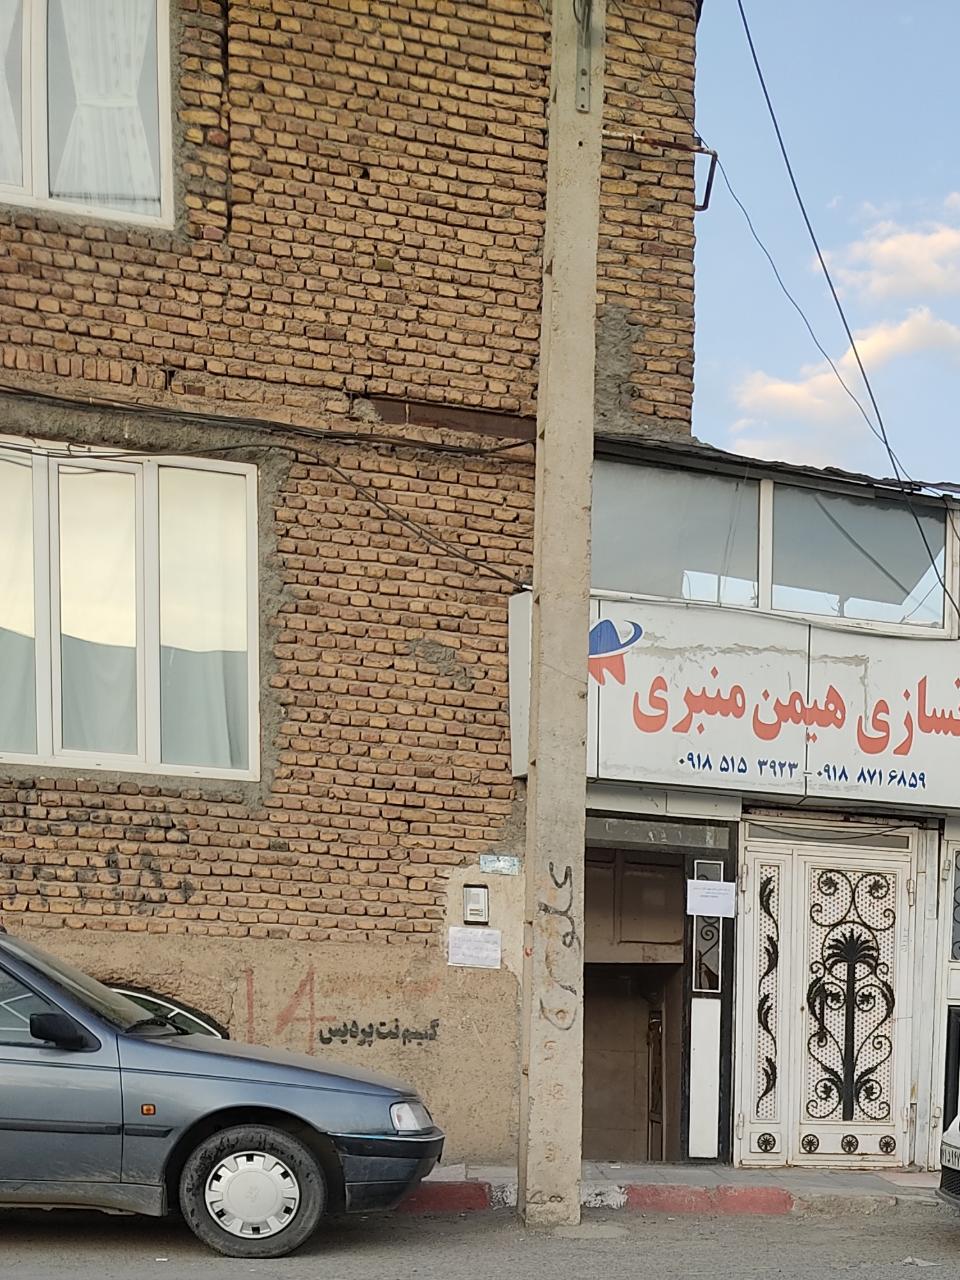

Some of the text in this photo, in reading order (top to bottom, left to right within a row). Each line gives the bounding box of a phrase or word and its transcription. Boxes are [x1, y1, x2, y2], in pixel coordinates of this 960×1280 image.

[633, 666, 746, 735] منبری
[752, 684, 846, 743] هیمن
[719, 755, 748, 774] ۵۱۵
[757, 759, 799, 779] ۳۹۲۳
